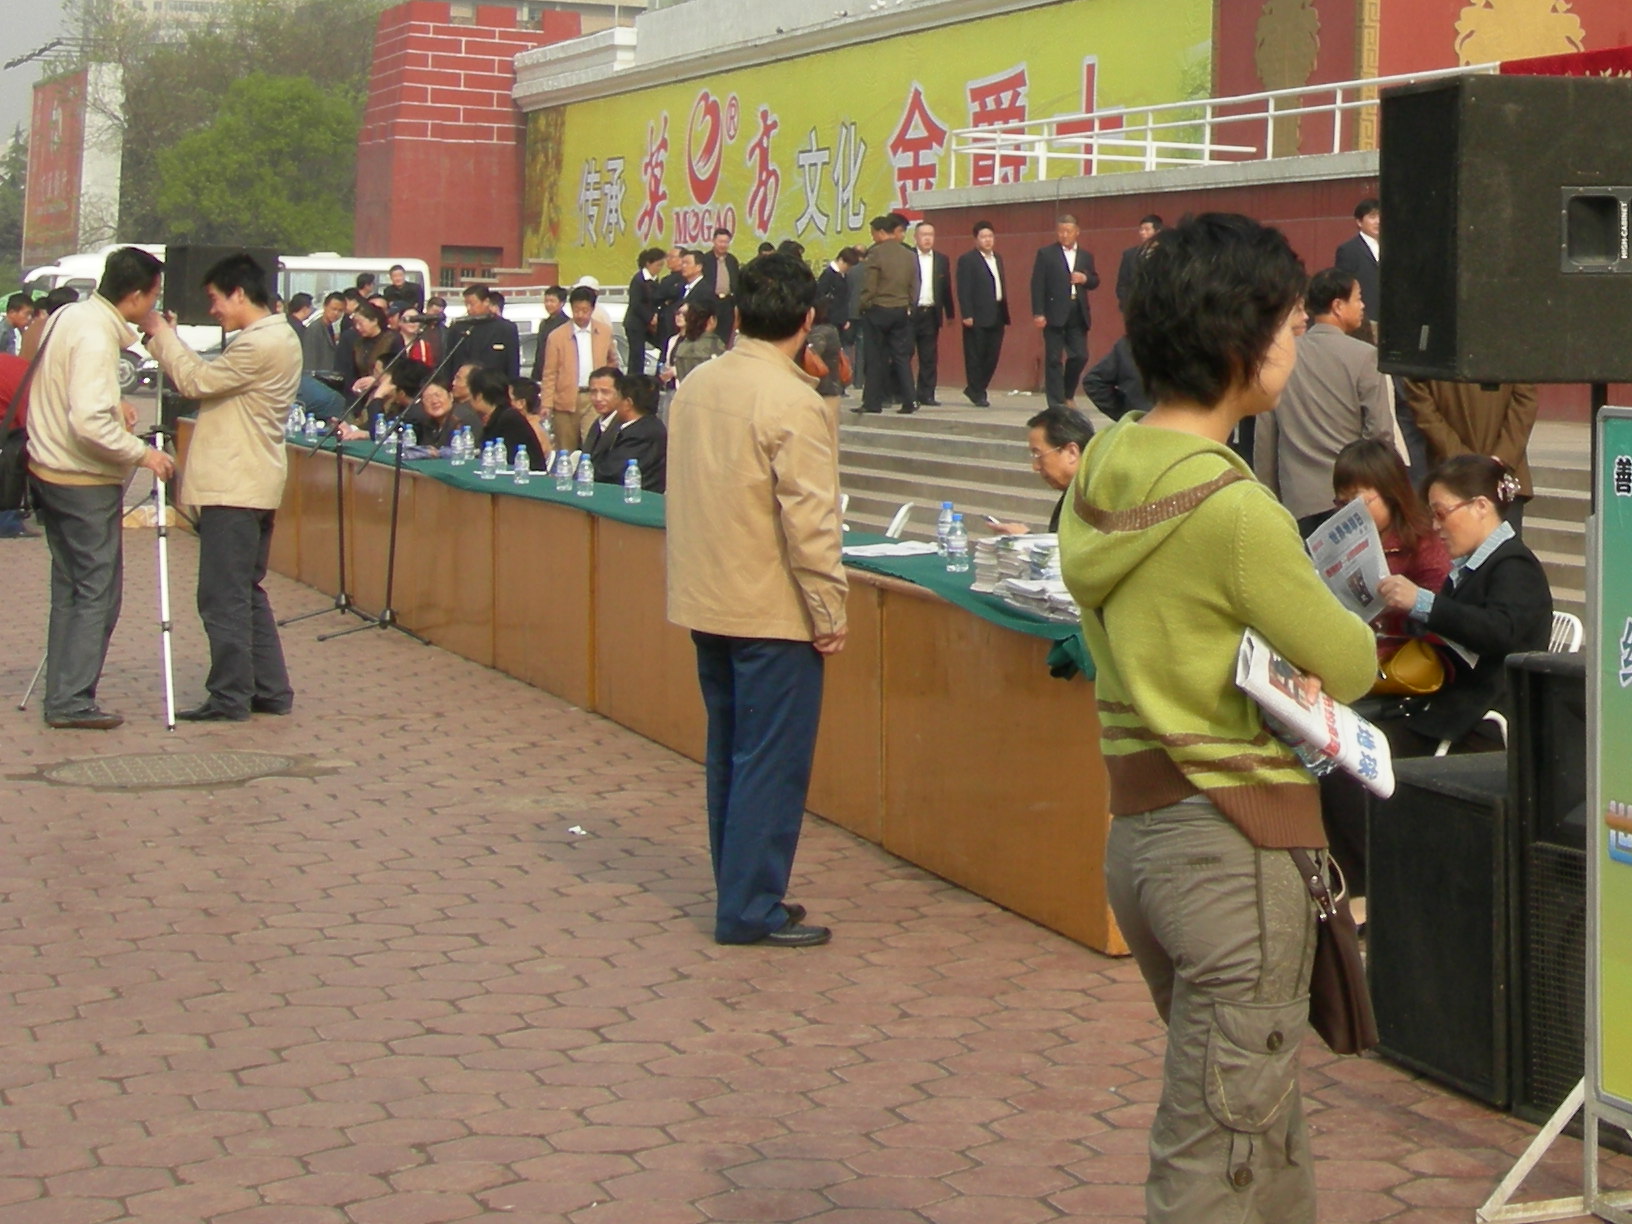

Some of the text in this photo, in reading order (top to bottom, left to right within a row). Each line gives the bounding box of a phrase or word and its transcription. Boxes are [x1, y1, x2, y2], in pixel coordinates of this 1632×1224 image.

[579, 156, 626, 247] 传承
[796, 121, 867, 237] 文化
[672, 204, 737, 244] MOGAO
